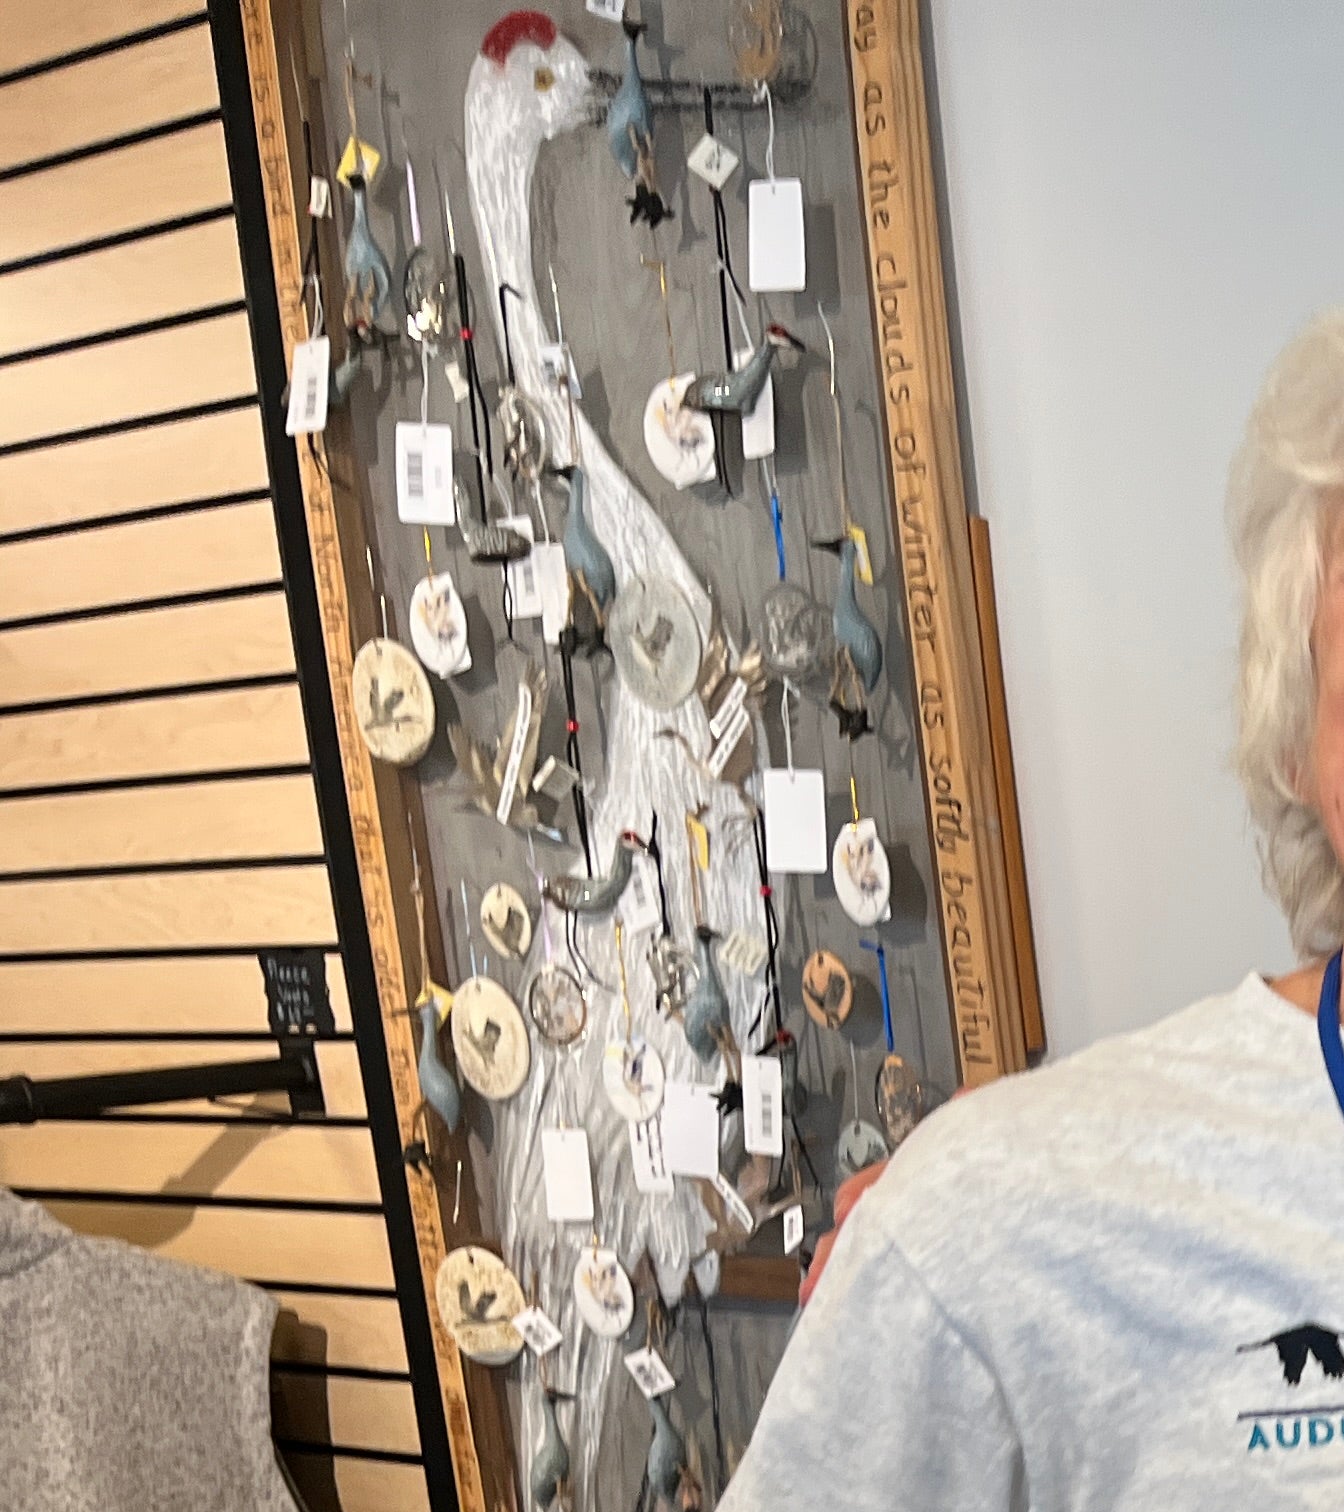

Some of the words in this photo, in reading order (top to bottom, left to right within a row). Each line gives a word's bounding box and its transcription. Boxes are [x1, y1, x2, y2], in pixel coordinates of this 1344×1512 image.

[854, 0, 877, 52] ay
[862, 81, 886, 137] as
[867, 159, 900, 230] the
[875, 255, 909, 406] clouds
[893, 430, 927, 473] of
[900, 496, 936, 656] winter
[919, 681, 945, 732] as
[940, 870, 994, 1066] beautiful
